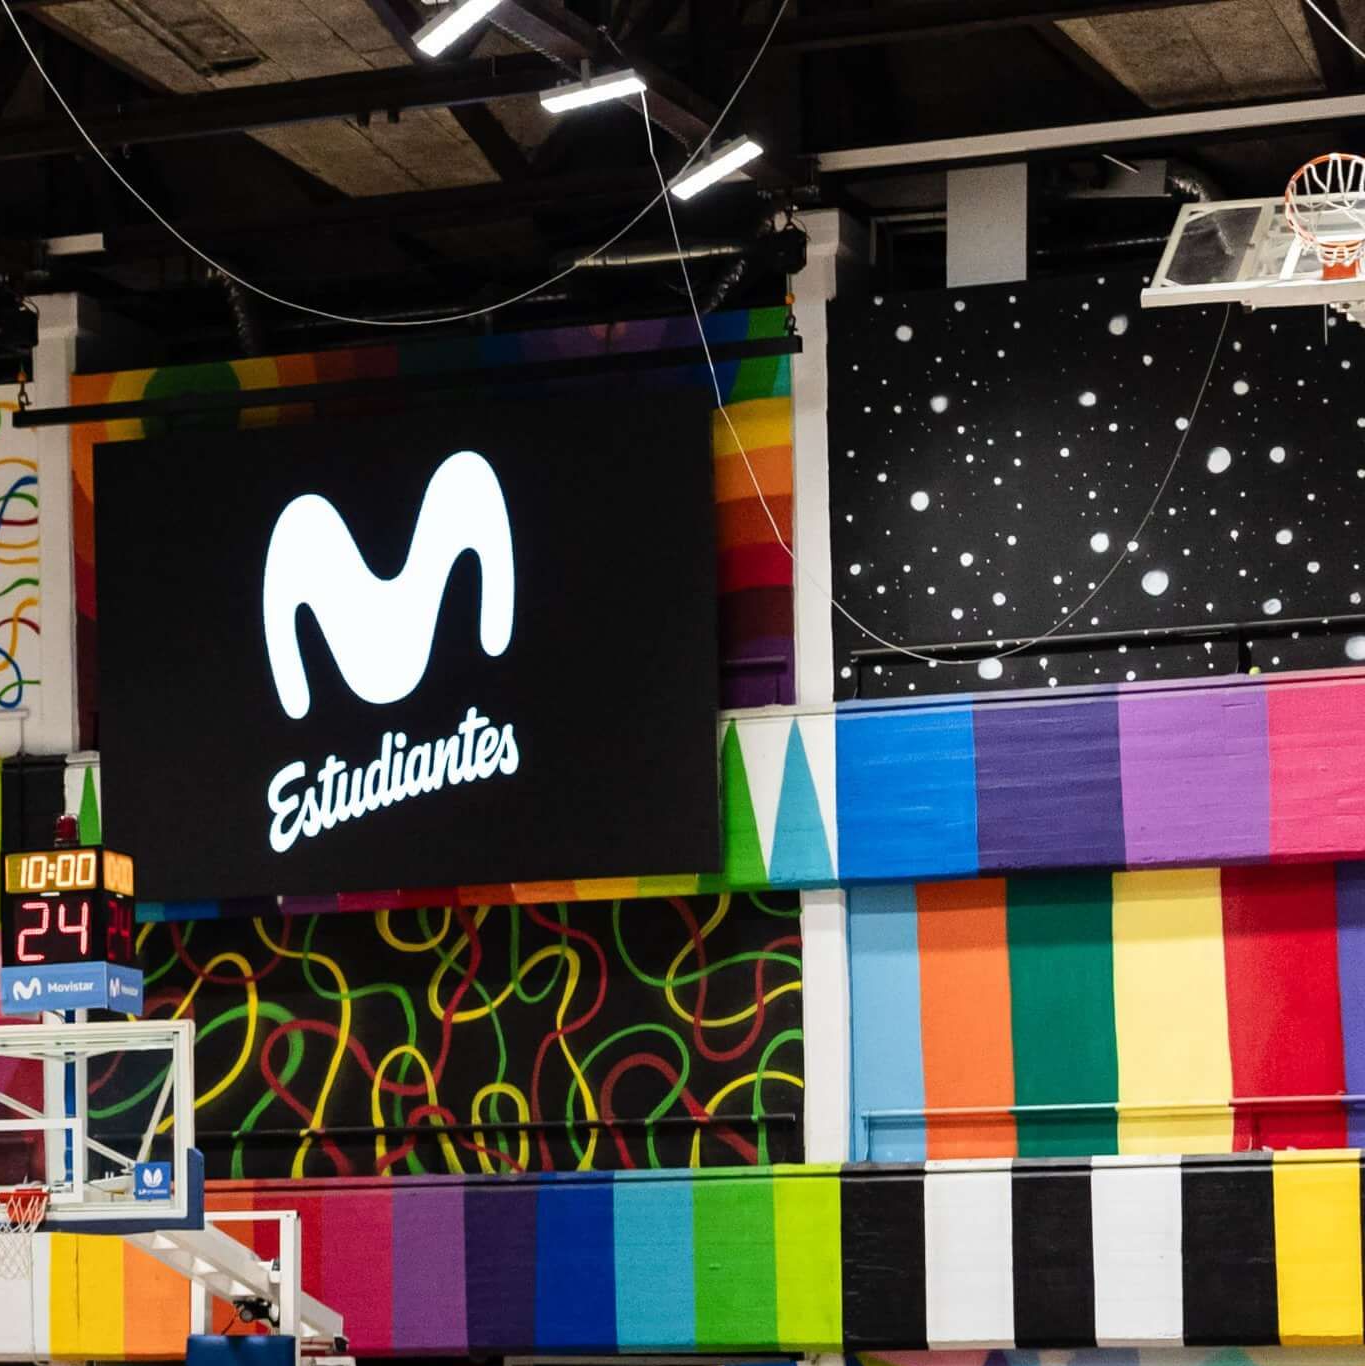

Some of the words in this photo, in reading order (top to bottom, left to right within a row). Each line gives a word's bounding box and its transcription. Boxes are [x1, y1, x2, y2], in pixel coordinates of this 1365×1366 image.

[267, 706, 519, 853] Estudiantes
[20, 852, 97, 889] 10:00
[17, 901, 90, 962] 24
[47, 981, 95, 993] Movistar
